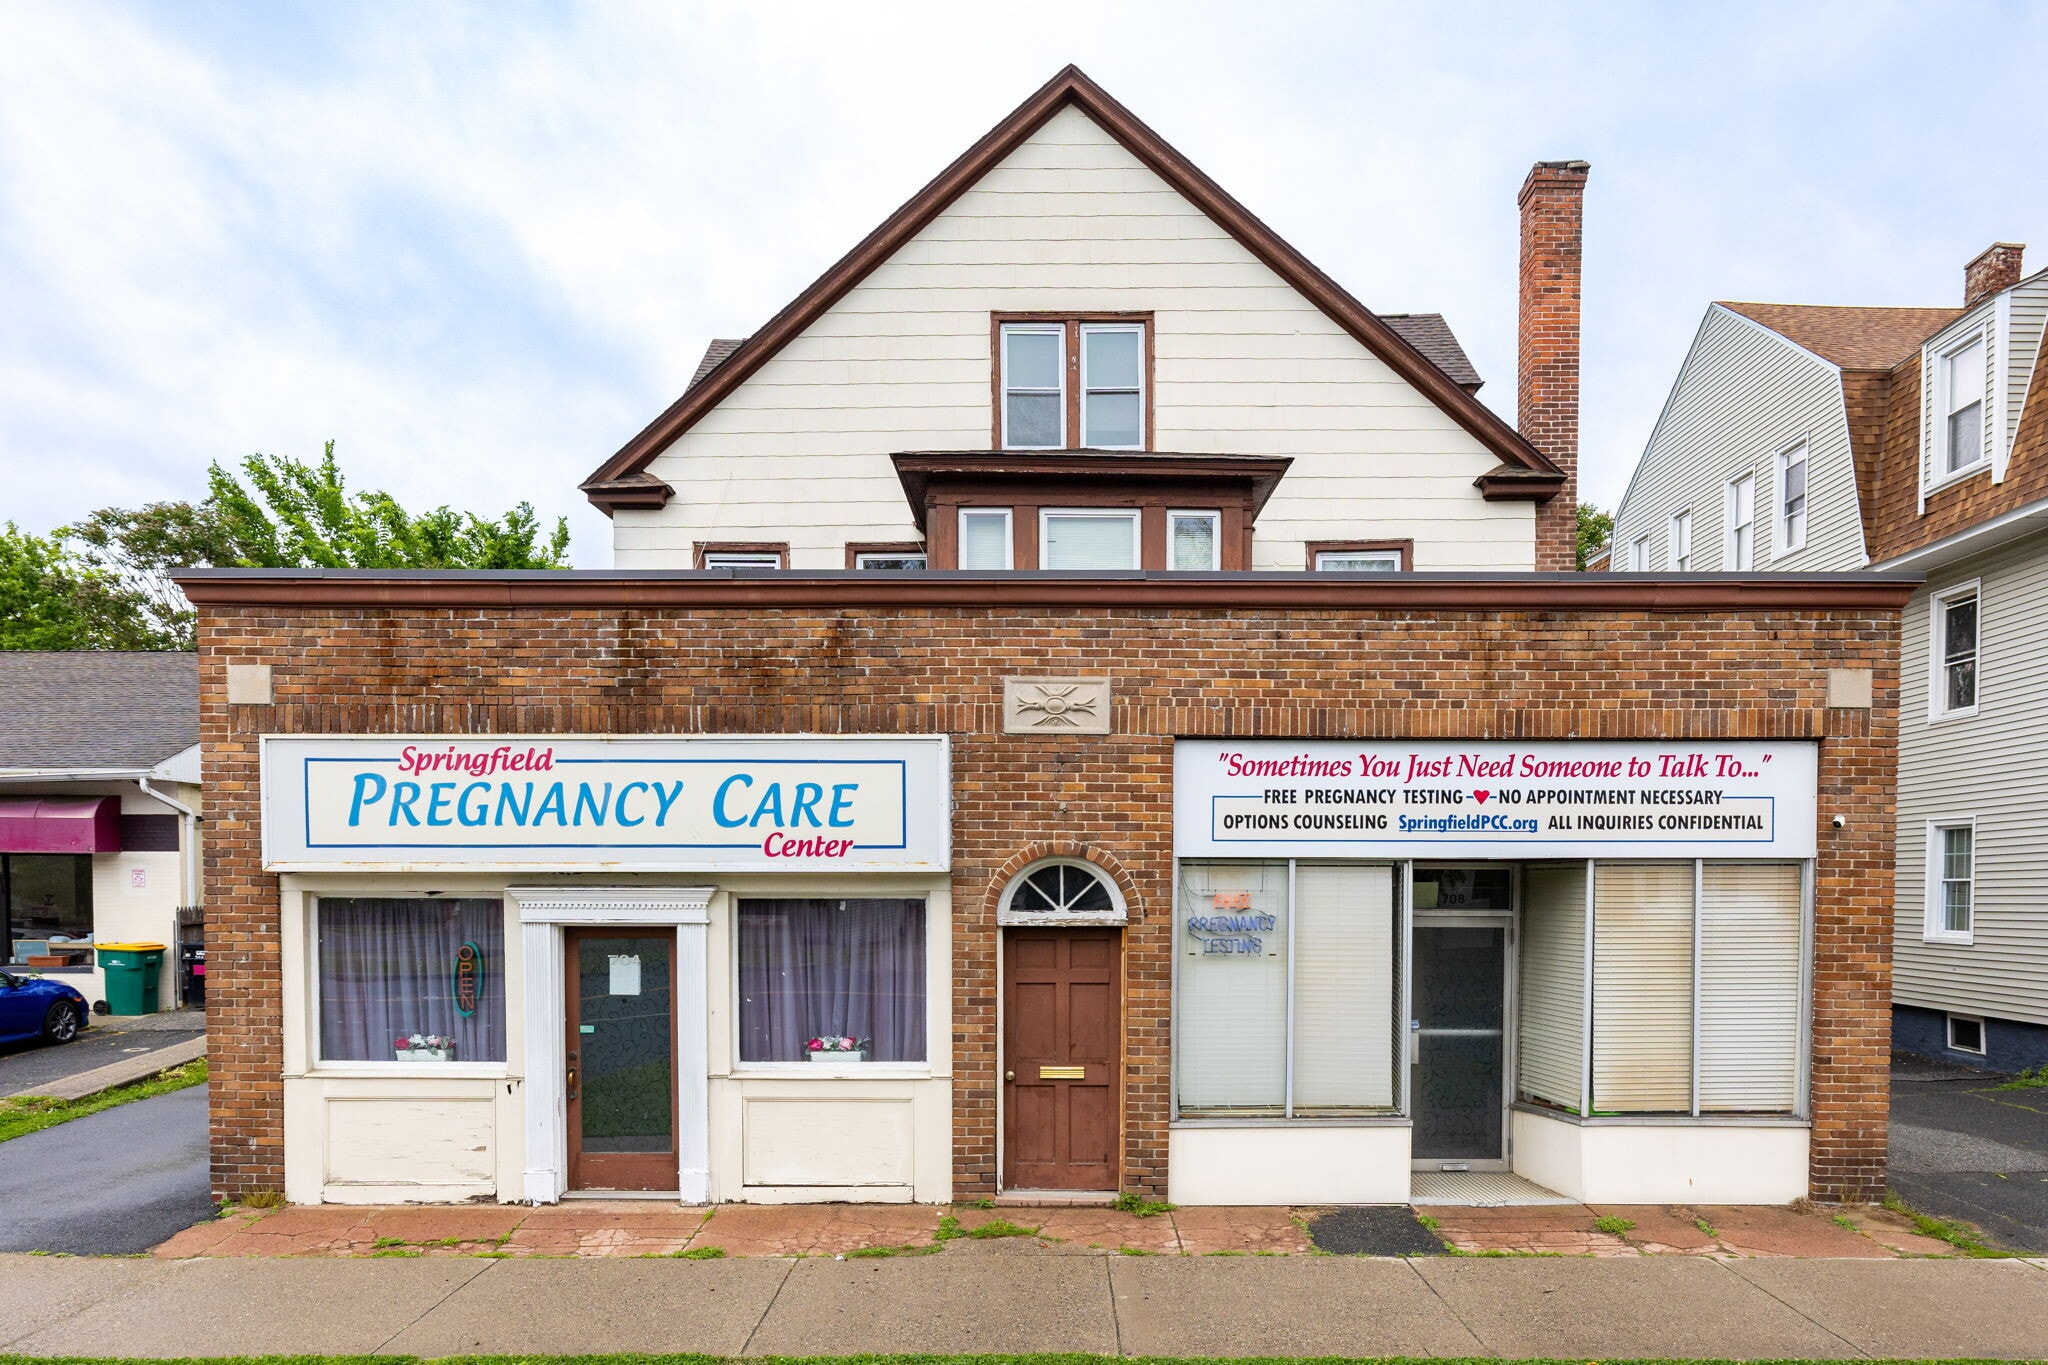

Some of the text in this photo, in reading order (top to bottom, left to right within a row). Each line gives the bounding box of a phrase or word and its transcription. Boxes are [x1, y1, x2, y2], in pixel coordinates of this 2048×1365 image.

[398, 745, 553, 777] Springfield
[1218, 753, 1352, 777] "Sometimes
[1359, 754, 1401, 778] You
[1404, 754, 1453, 784] Just
[1456, 754, 1516, 778] Need
[1520, 754, 1622, 778] Someone
[1628, 757, 1652, 778] to
[1658, 754, 1709, 778] Talk
[348, 772, 859, 829] PREGNANCY CARE
[1263, 789, 1723, 805] FREE PREGNANCY TESTING NO APPOINTMENT NECESSARY
[1223, 814, 1764, 833] OPTIONS COUNSELING SpringfieldPCC.org ALL INQUIRIES CONFIDENTIAL
[763, 831, 854, 859] Center
[1442, 893, 1466, 905] 708
[457, 945, 475, 1009] OPEN
